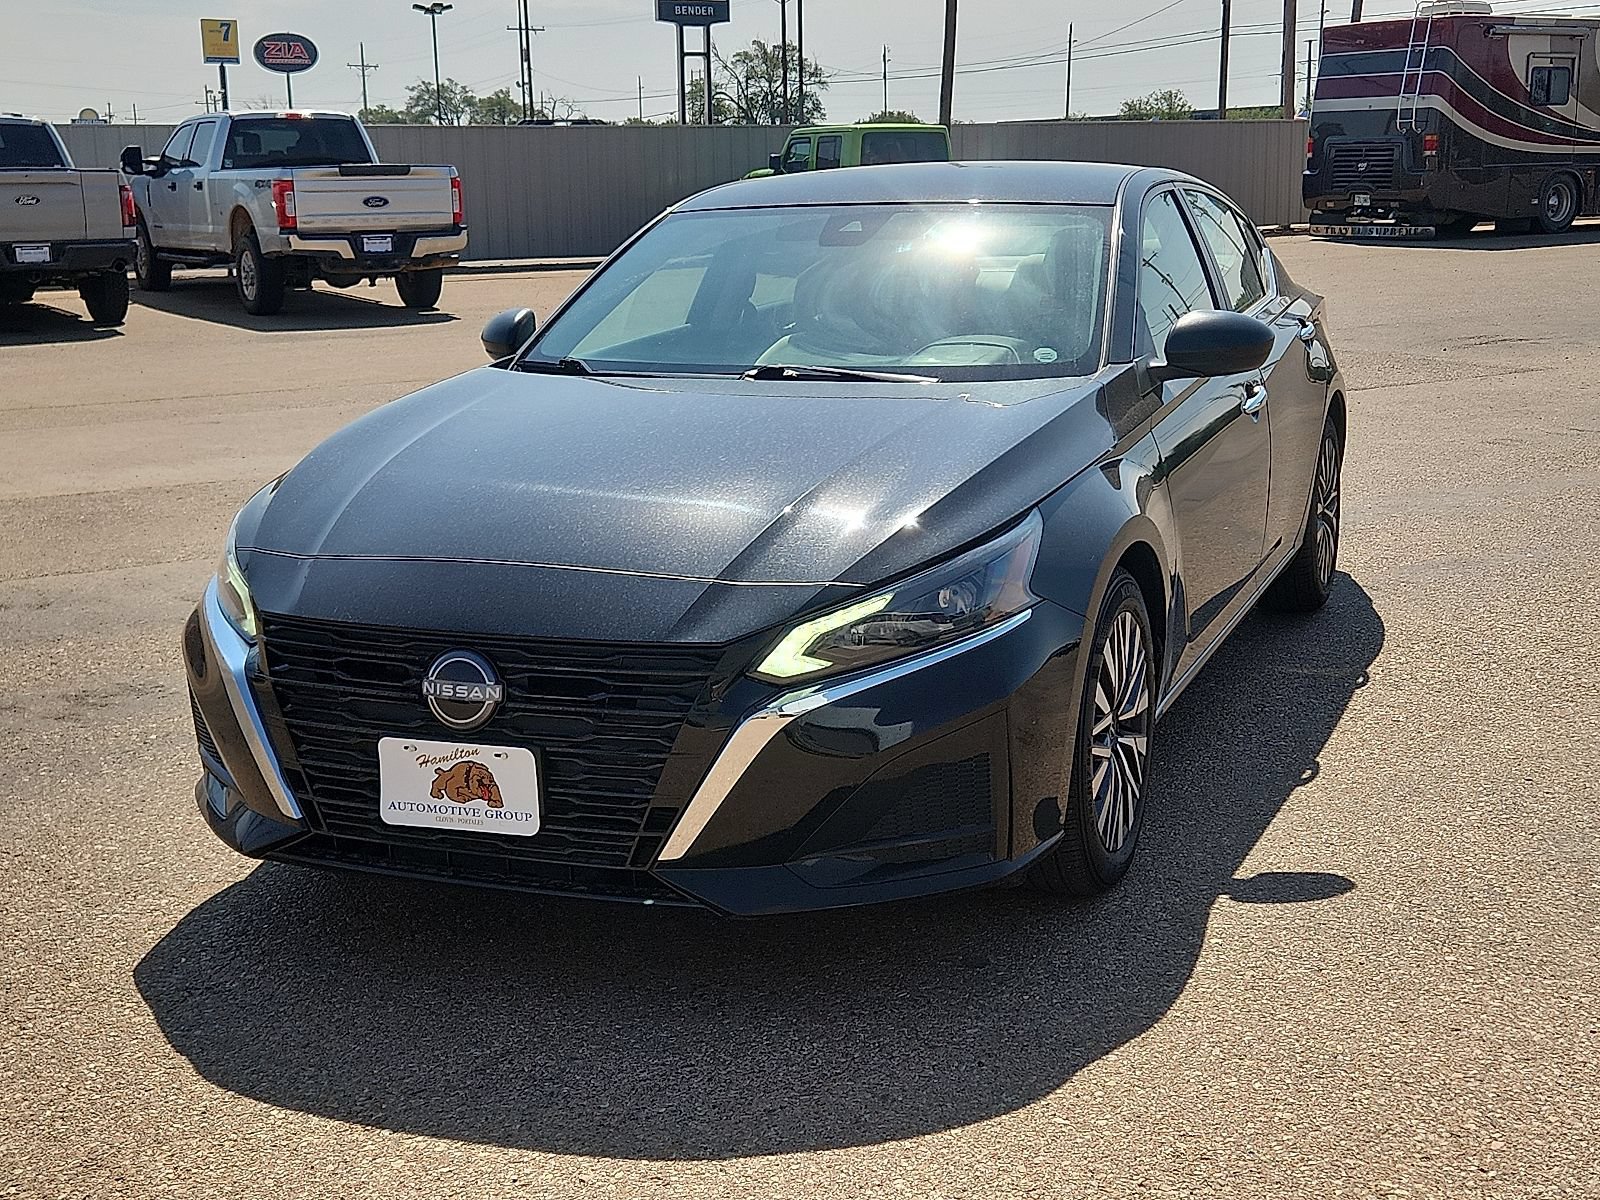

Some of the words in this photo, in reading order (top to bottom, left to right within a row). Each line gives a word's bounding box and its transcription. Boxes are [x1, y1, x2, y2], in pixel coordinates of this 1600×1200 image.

[675, 6, 714, 16] BENDER
[219, 22, 231, 42] 7
[263, 41, 309, 59] ZIA
[1324, 226, 1363, 236] TRAVEL
[1368, 226, 1418, 236] SUPREME
[422, 682, 501, 699] NISSAN
[415, 747, 481, 768] Hamilton
[388, 801, 481, 818] AUTOMOTIVE
[484, 809, 533, 822] GROUP
